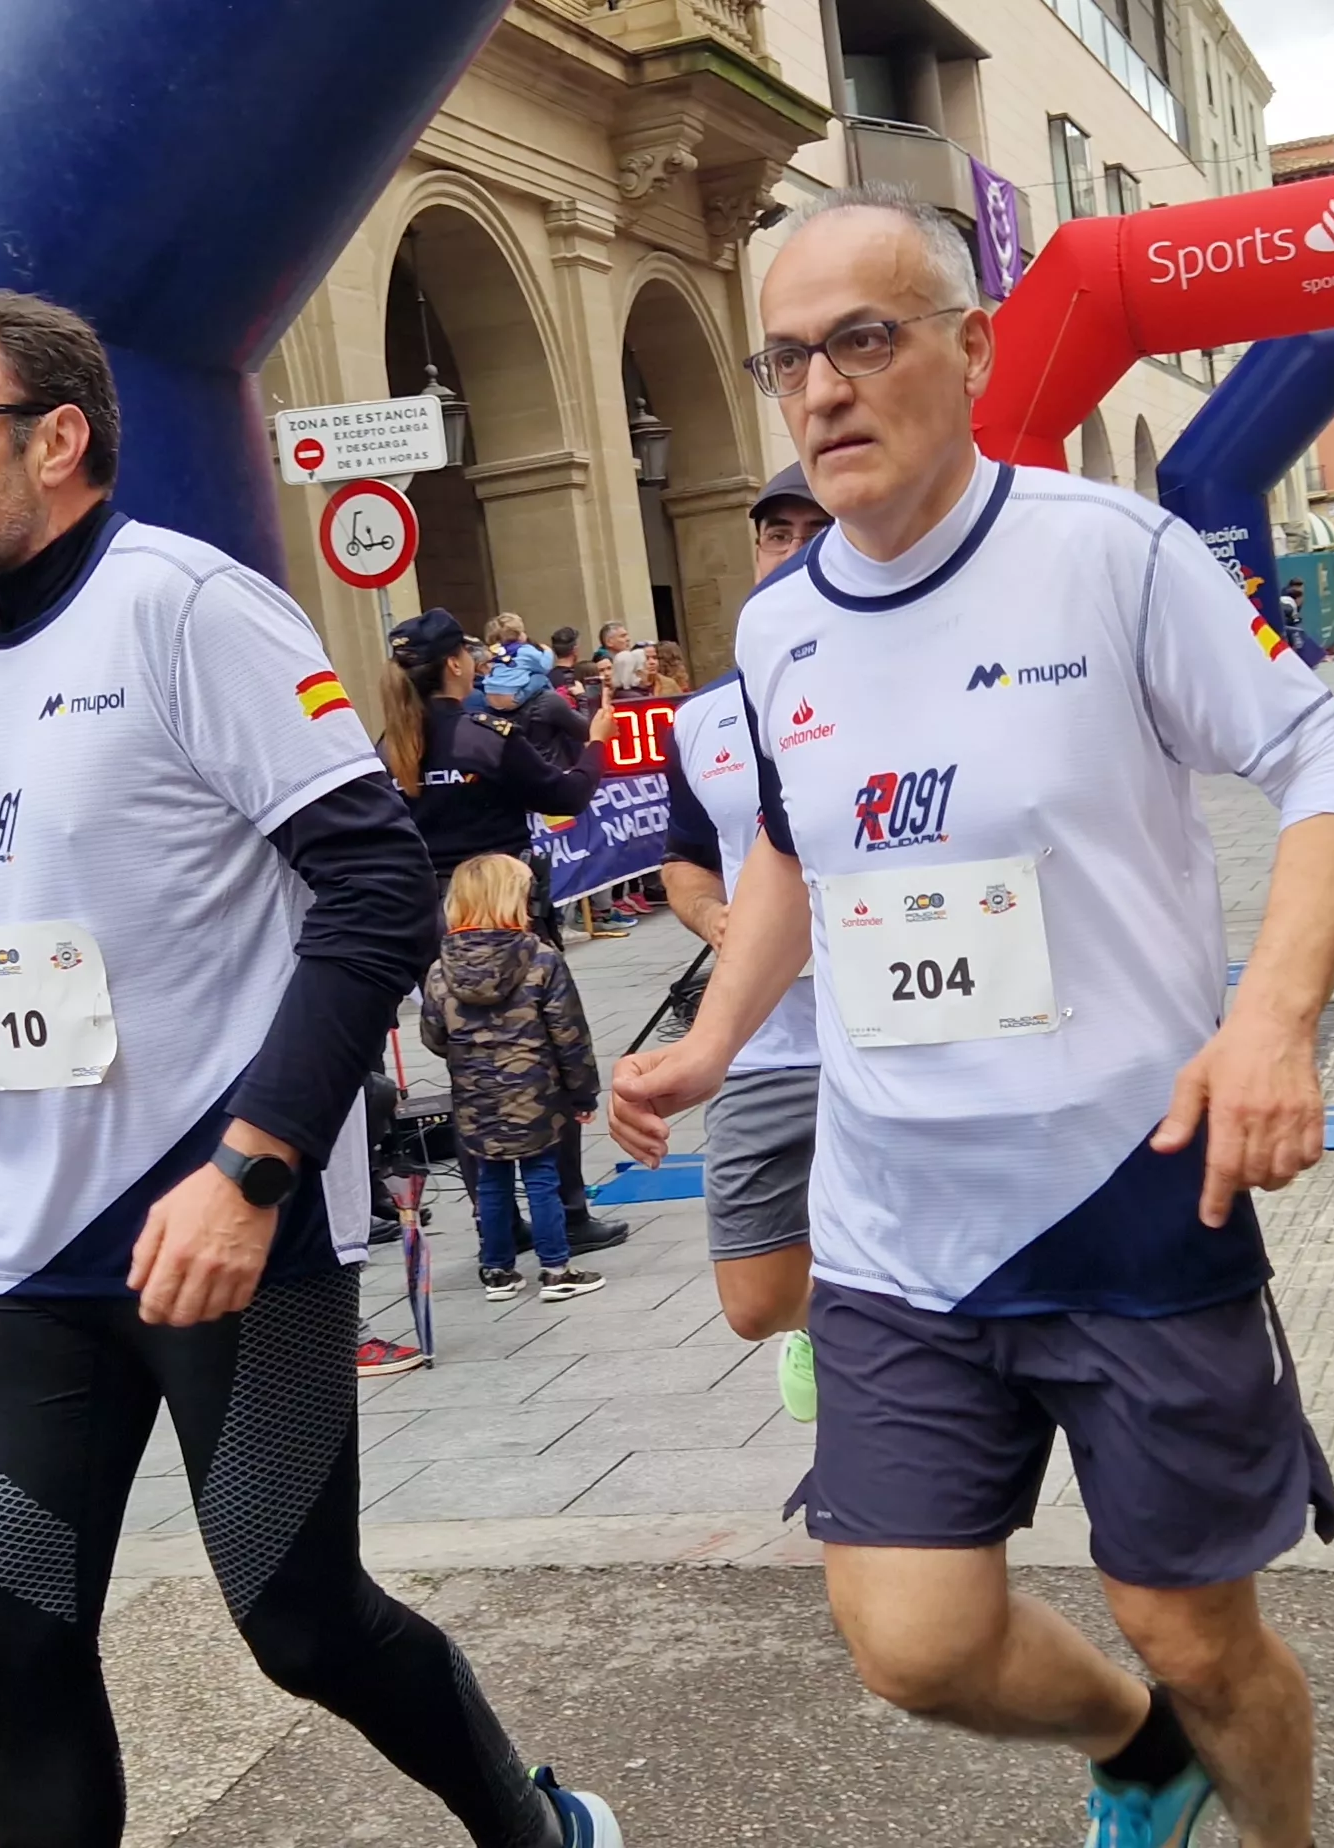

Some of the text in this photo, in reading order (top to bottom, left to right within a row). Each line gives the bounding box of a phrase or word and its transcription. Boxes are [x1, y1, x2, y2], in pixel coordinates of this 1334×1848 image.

[1147, 225, 1297, 290] Sports
[289, 407, 429, 432] ZONA DE ESTANCIA
[334, 422, 429, 441] EXCEPTO CARGA
[336, 439, 408, 454] Y DESCARGA
[338, 459, 352, 470] DE
[366, 457, 375, 466] A
[390, 451, 429, 464] HORAS
[1198, 525, 1249, 544] dación
[1017, 655, 1088, 686] mupol
[70, 687, 125, 715] mupol
[779, 724, 836, 752] Santander
[865, 832, 944, 853] SOLIDARIA
[842, 917, 884, 928] Santander
[888, 957, 975, 1001] 204
